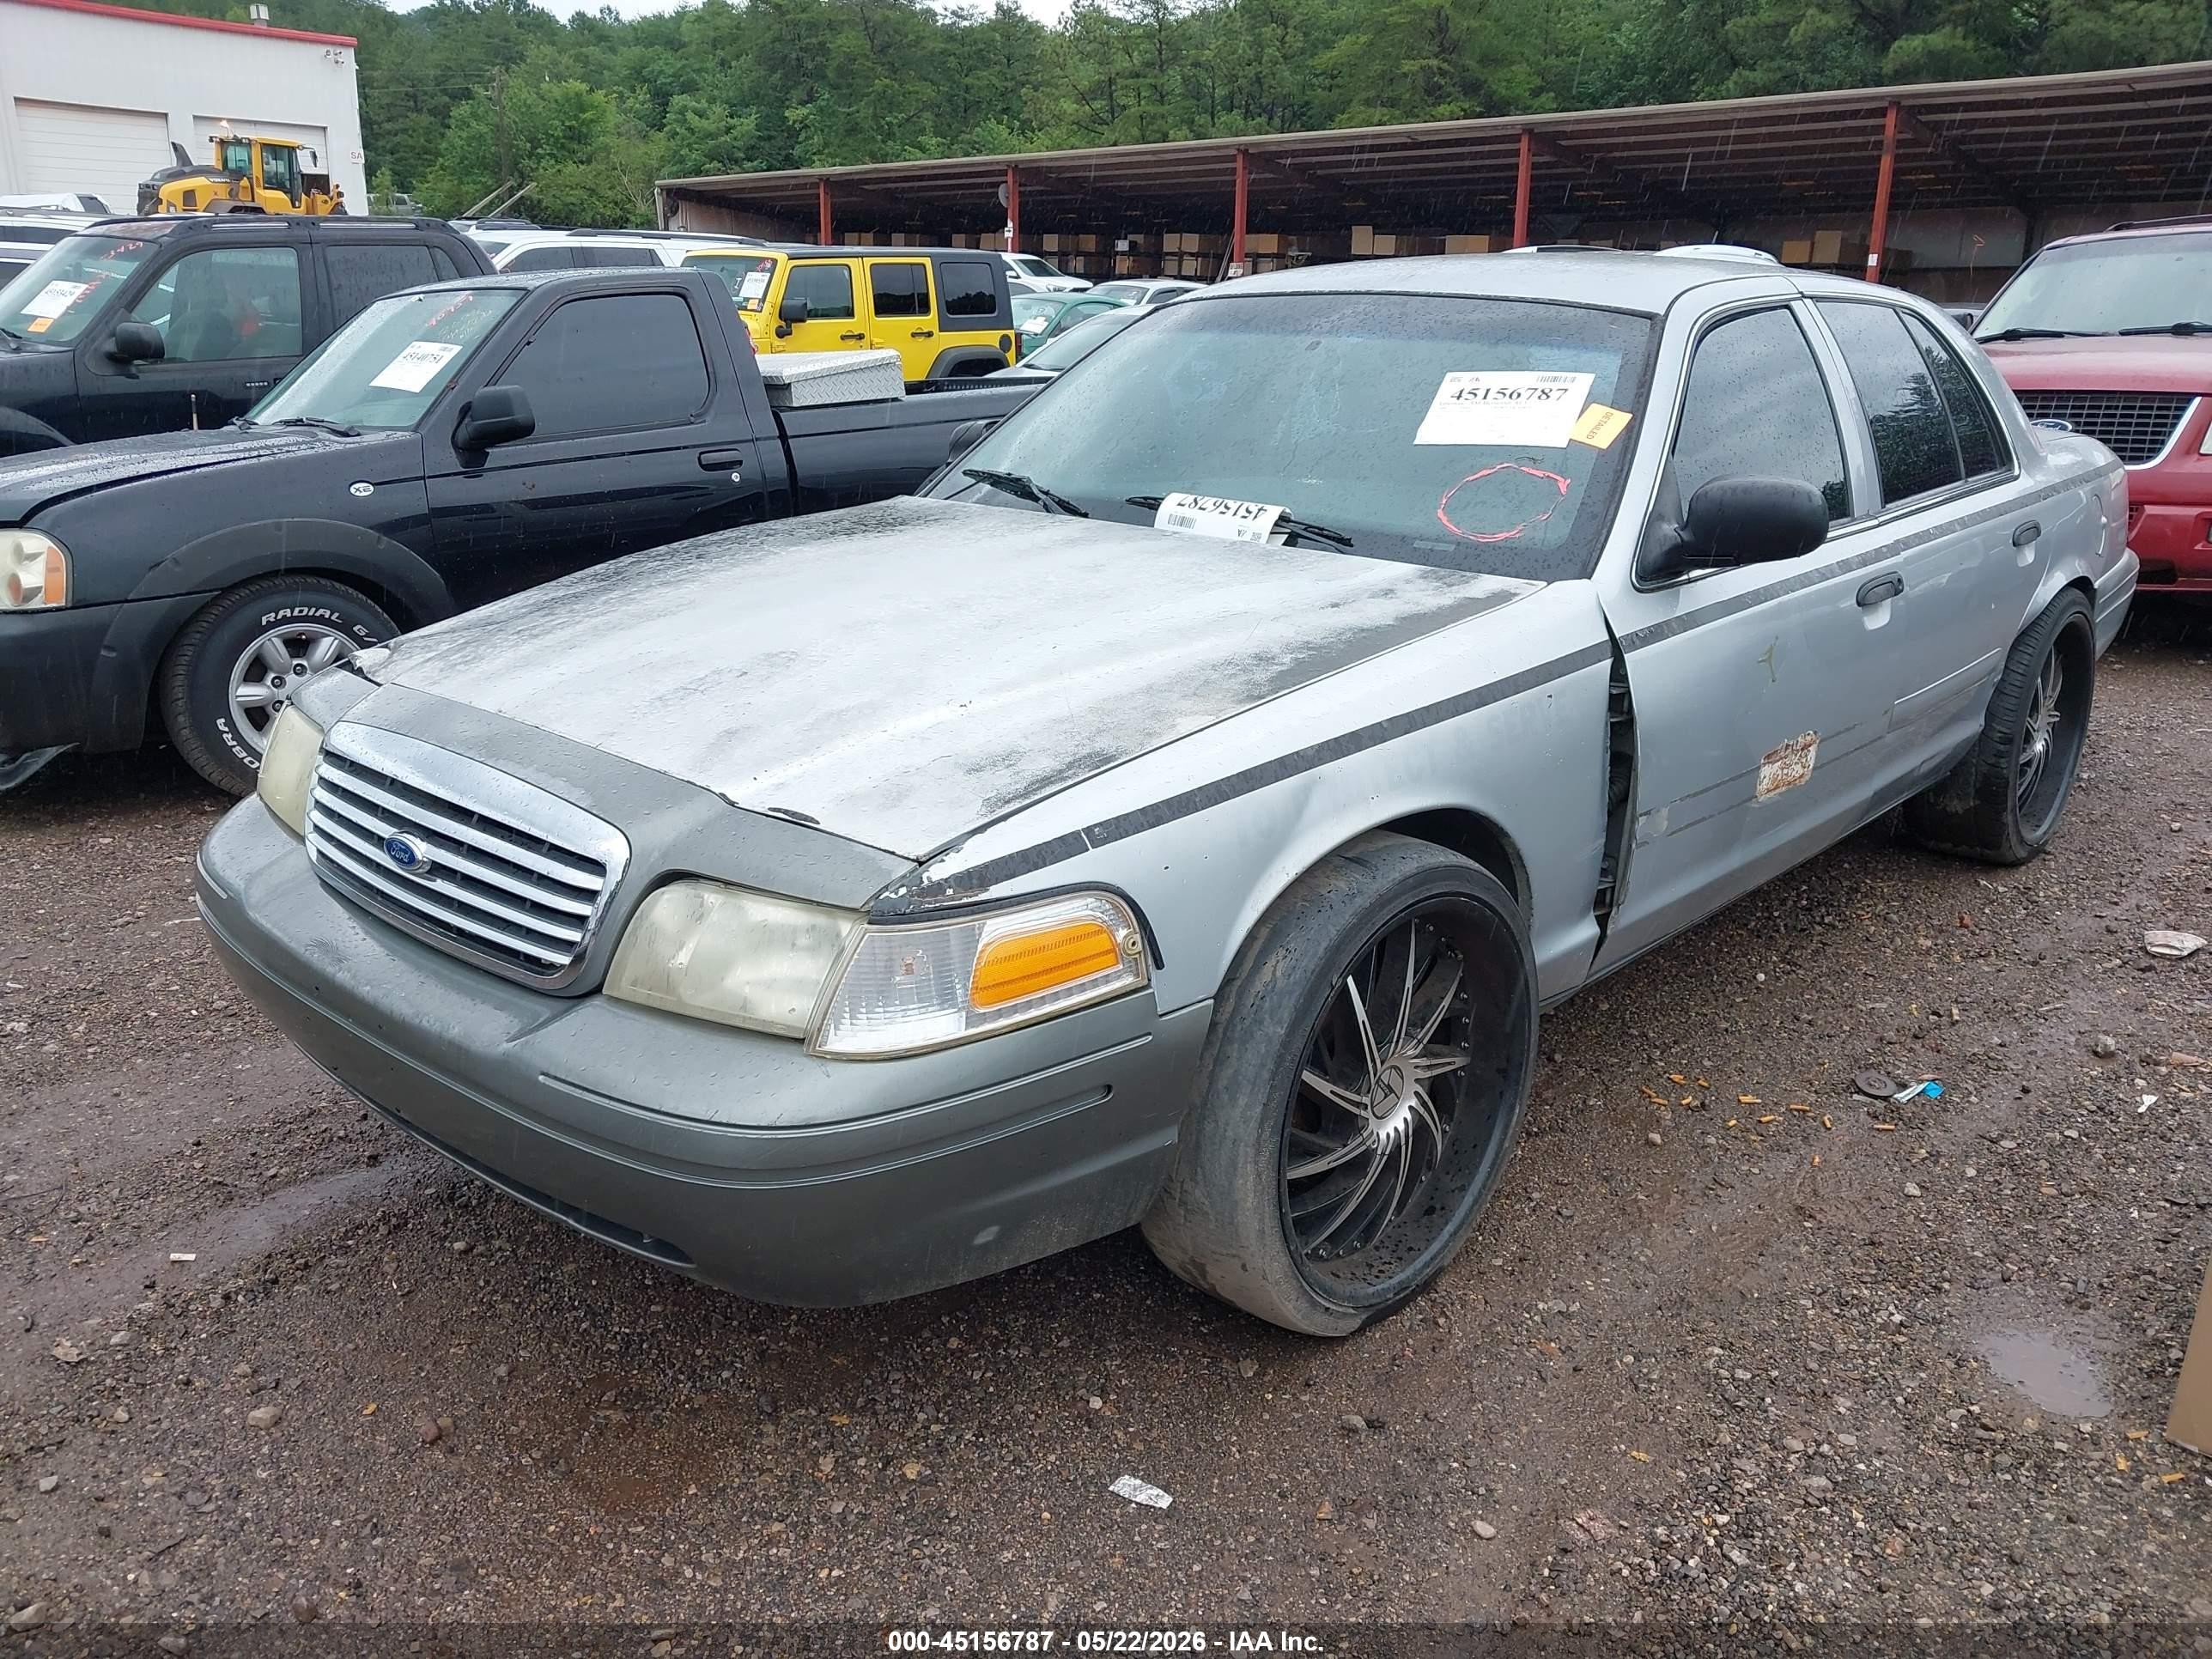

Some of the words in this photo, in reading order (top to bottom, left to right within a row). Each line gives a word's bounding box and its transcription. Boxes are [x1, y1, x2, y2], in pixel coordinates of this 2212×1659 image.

[1450, 387, 1569, 401] 45156787
[1586, 411, 1614, 440] DETAILED
[1176, 495, 1267, 521] 45156787
[261, 606, 343, 626] RADIAL
[216, 718, 260, 769] OBRA
[390, 842, 411, 862] Ford
